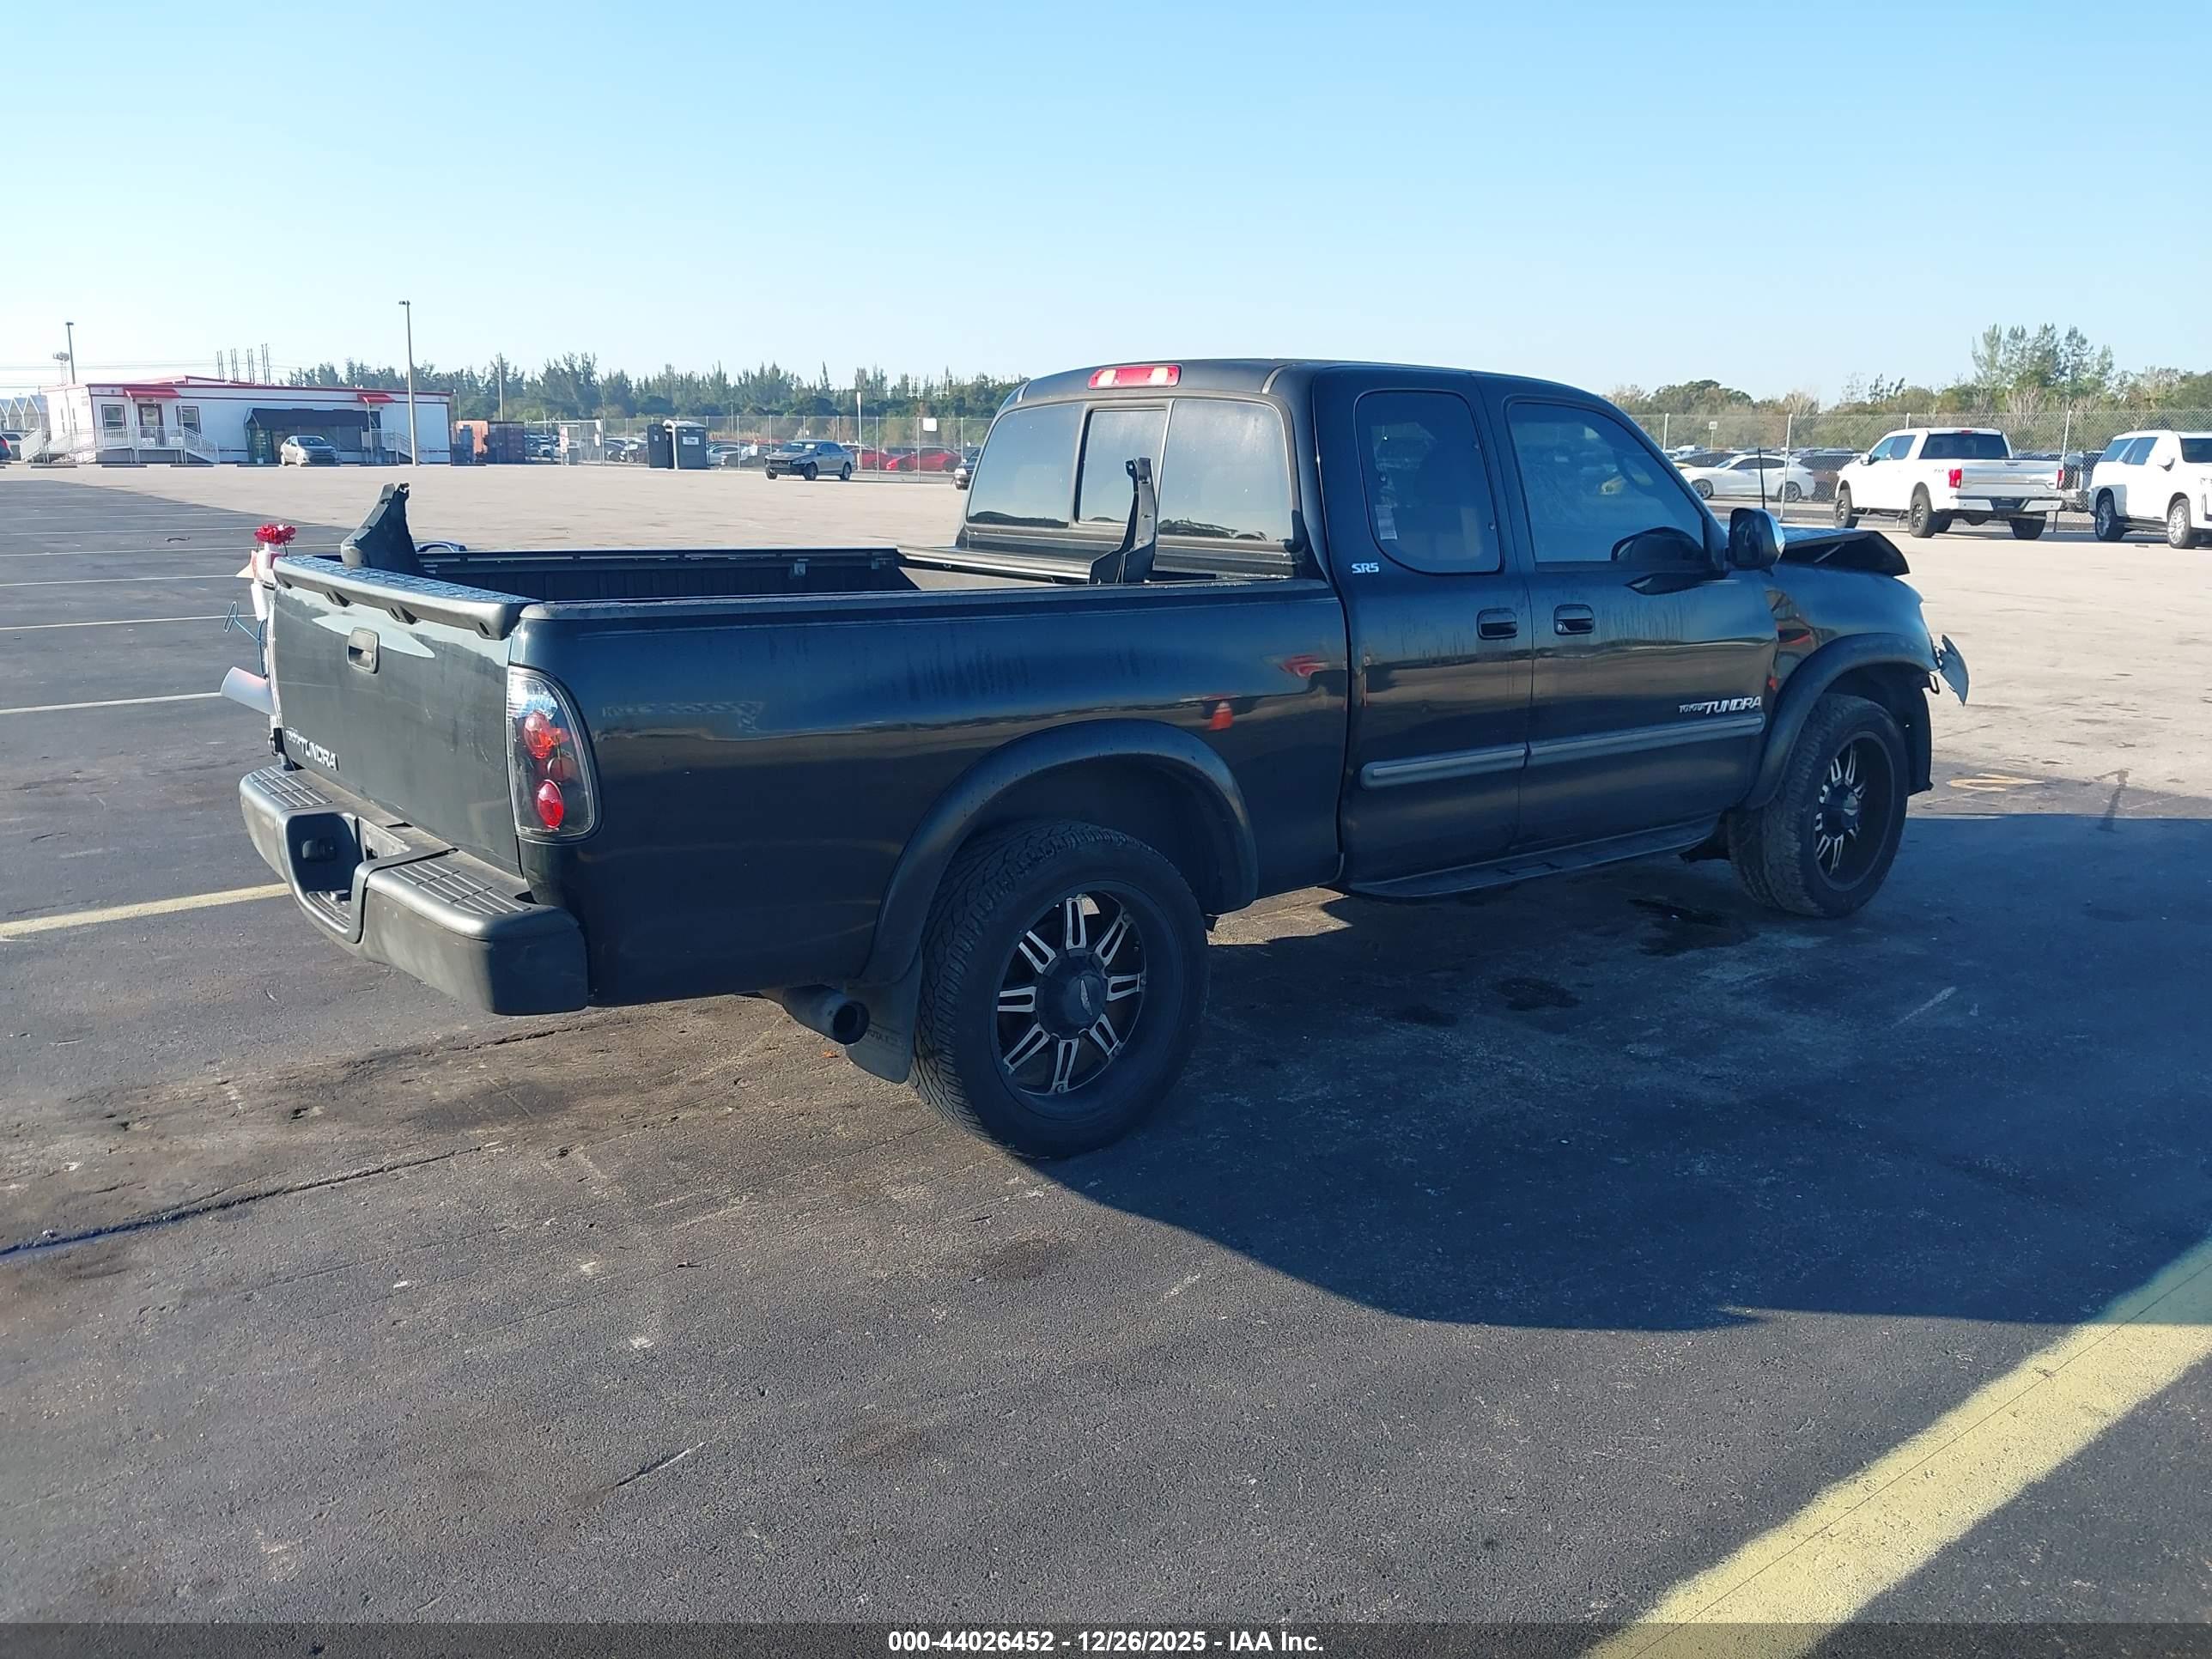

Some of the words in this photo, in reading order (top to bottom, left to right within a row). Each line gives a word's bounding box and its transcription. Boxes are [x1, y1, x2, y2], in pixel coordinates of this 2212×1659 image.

[1351, 562, 1379, 574] SR5
[1705, 696, 1761, 714] TUNDRA
[298, 736, 339, 771] TUNDRA
